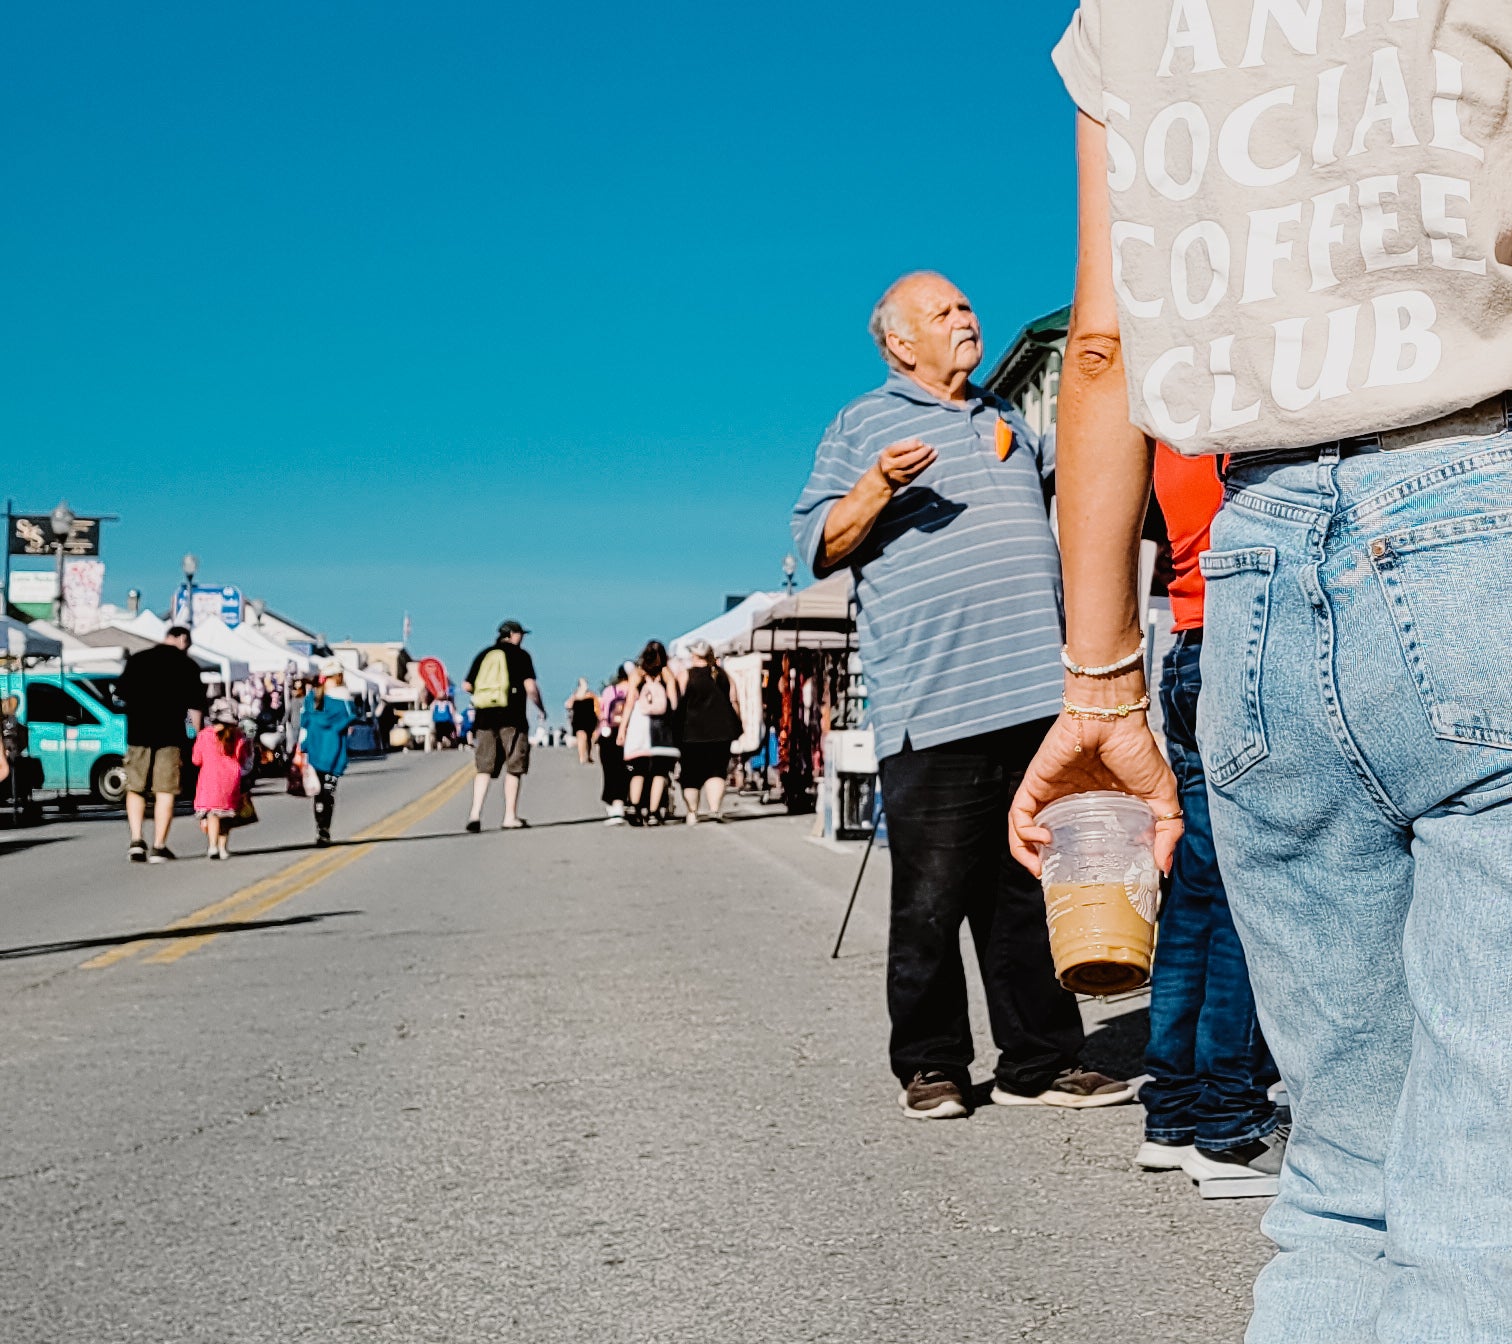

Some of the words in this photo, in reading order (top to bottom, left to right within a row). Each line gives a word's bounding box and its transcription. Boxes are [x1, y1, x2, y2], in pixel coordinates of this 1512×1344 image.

[1102, 46, 1485, 201] SOCIAL
[1111, 173, 1487, 320] COFFEE
[1142, 289, 1443, 441] CLUB
